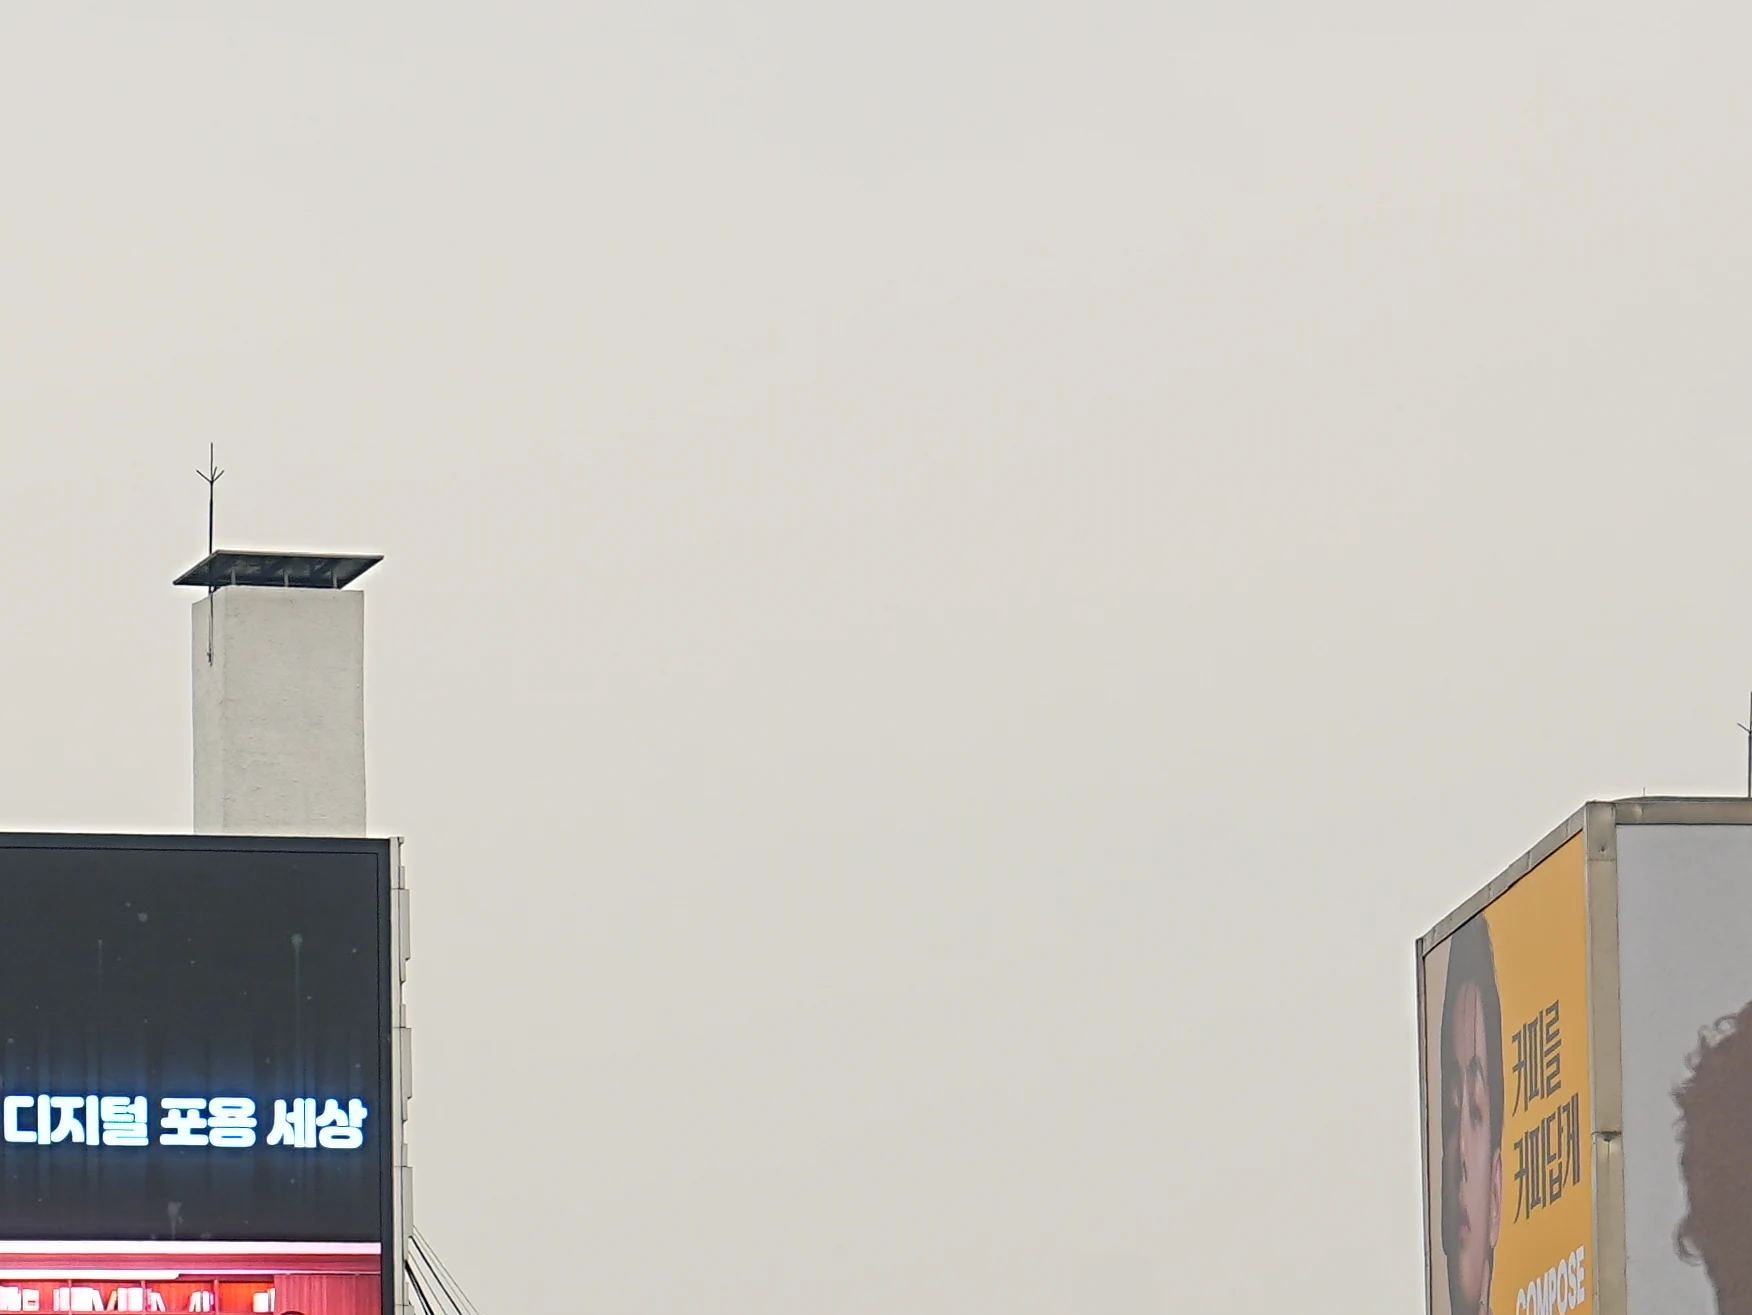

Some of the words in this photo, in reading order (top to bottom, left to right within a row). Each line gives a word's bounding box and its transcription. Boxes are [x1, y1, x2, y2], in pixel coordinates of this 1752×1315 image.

[1510, 999, 1563, 1117] 커피를
[3, 1095, 148, 1148] 디지털
[158, 1097, 257, 1148] 포용
[267, 1097, 368, 1149] 세상
[1513, 1096, 1582, 1225] 커피답게
